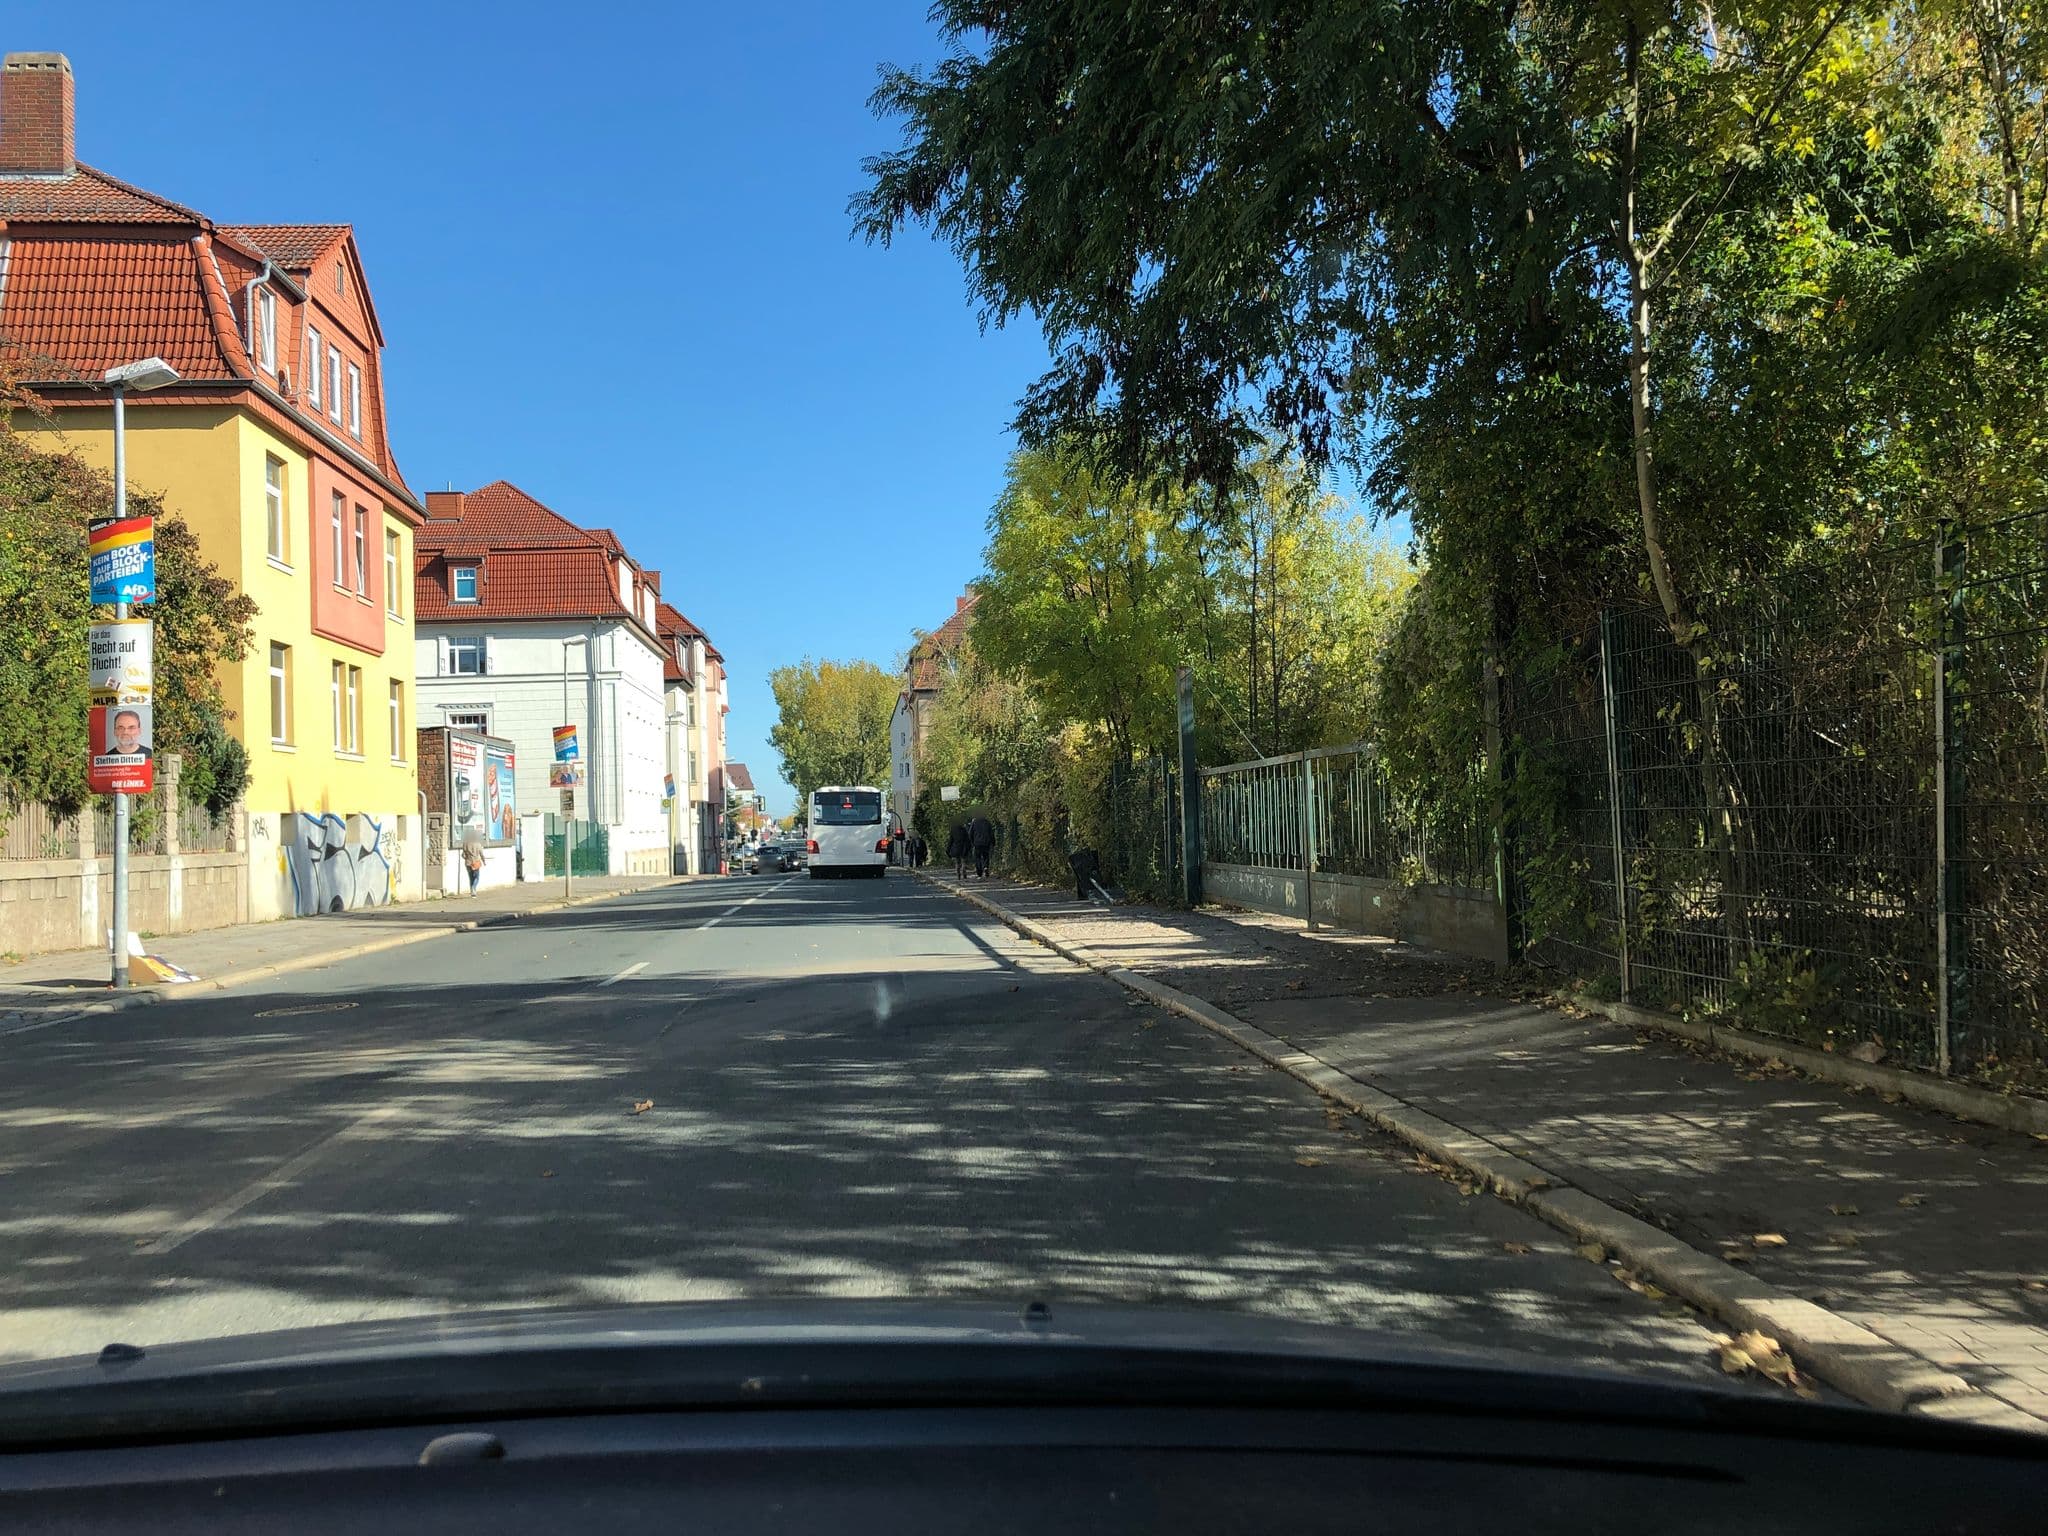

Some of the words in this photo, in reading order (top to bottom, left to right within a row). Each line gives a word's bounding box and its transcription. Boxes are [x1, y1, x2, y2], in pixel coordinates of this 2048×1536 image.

[93, 554, 110, 567] KEIN
[111, 544, 141, 559] BOCK
[96, 564, 111, 575] AUF
[112, 552, 152, 570] BLOCK-
[93, 562, 144, 586] PARTEIEN!
[122, 584, 147, 595] AfD
[92, 640, 116, 655] Recht
[119, 639, 136, 652] auf
[92, 656, 121, 671] Flucht!
